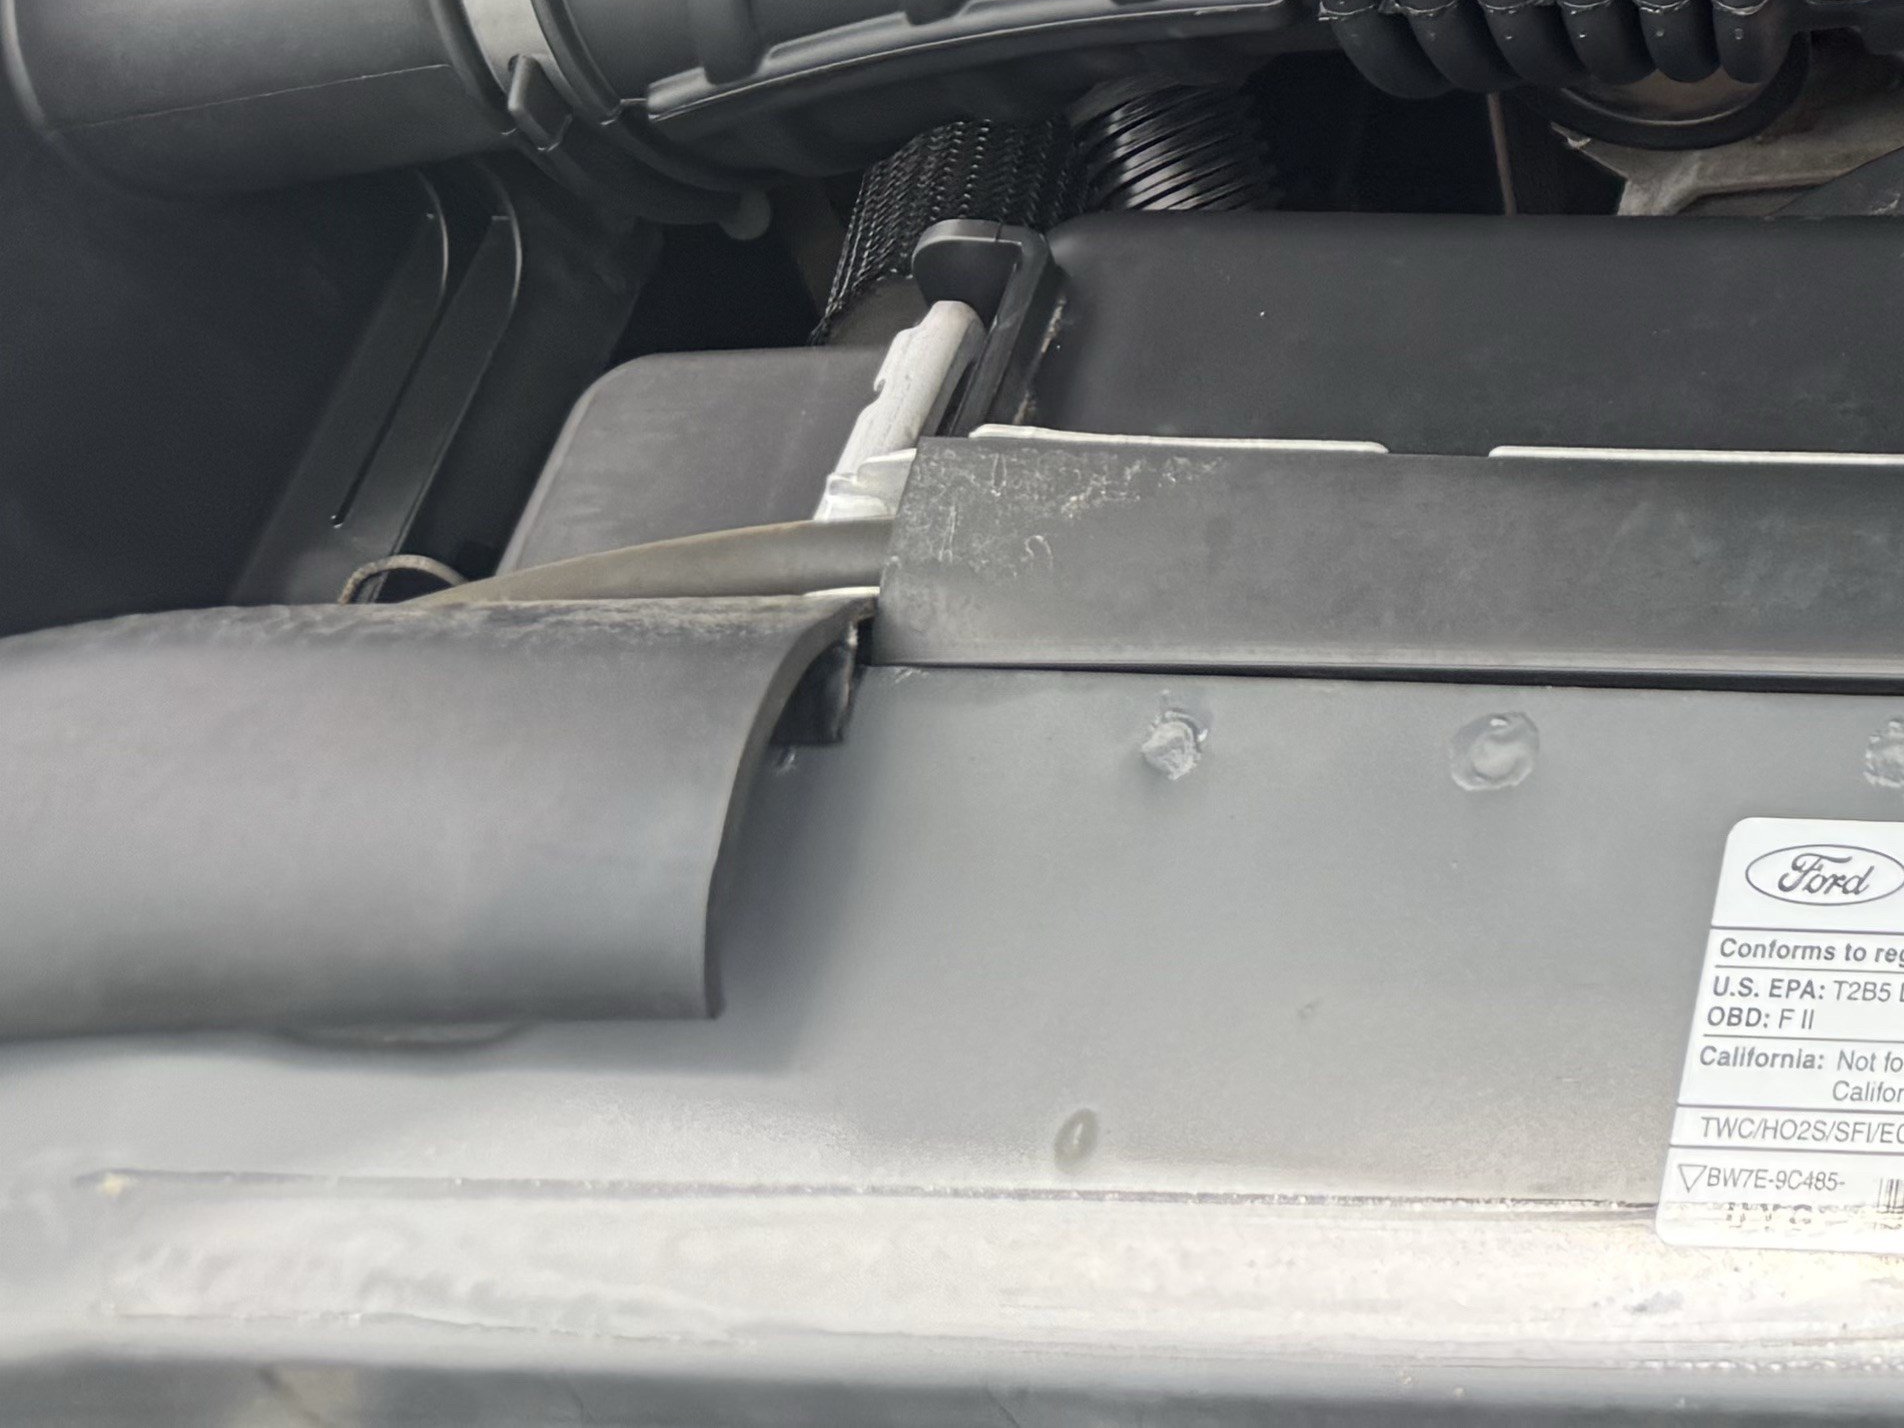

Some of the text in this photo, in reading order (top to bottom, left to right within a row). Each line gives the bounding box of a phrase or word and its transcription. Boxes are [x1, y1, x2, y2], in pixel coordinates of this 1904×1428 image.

[1776, 852, 1872, 897] Ford
[1719, 936, 1836, 961] Conforms
[1844, 942, 1867, 962] to
[1712, 975, 1759, 998] U.S.
[1767, 977, 1825, 1000] EPA:
[1832, 979, 1891, 1003] T2B5
[1706, 1005, 1814, 1030] OBD: F II
[1699, 1044, 1824, 1070] California:
[1836, 1049, 1877, 1072] Not
